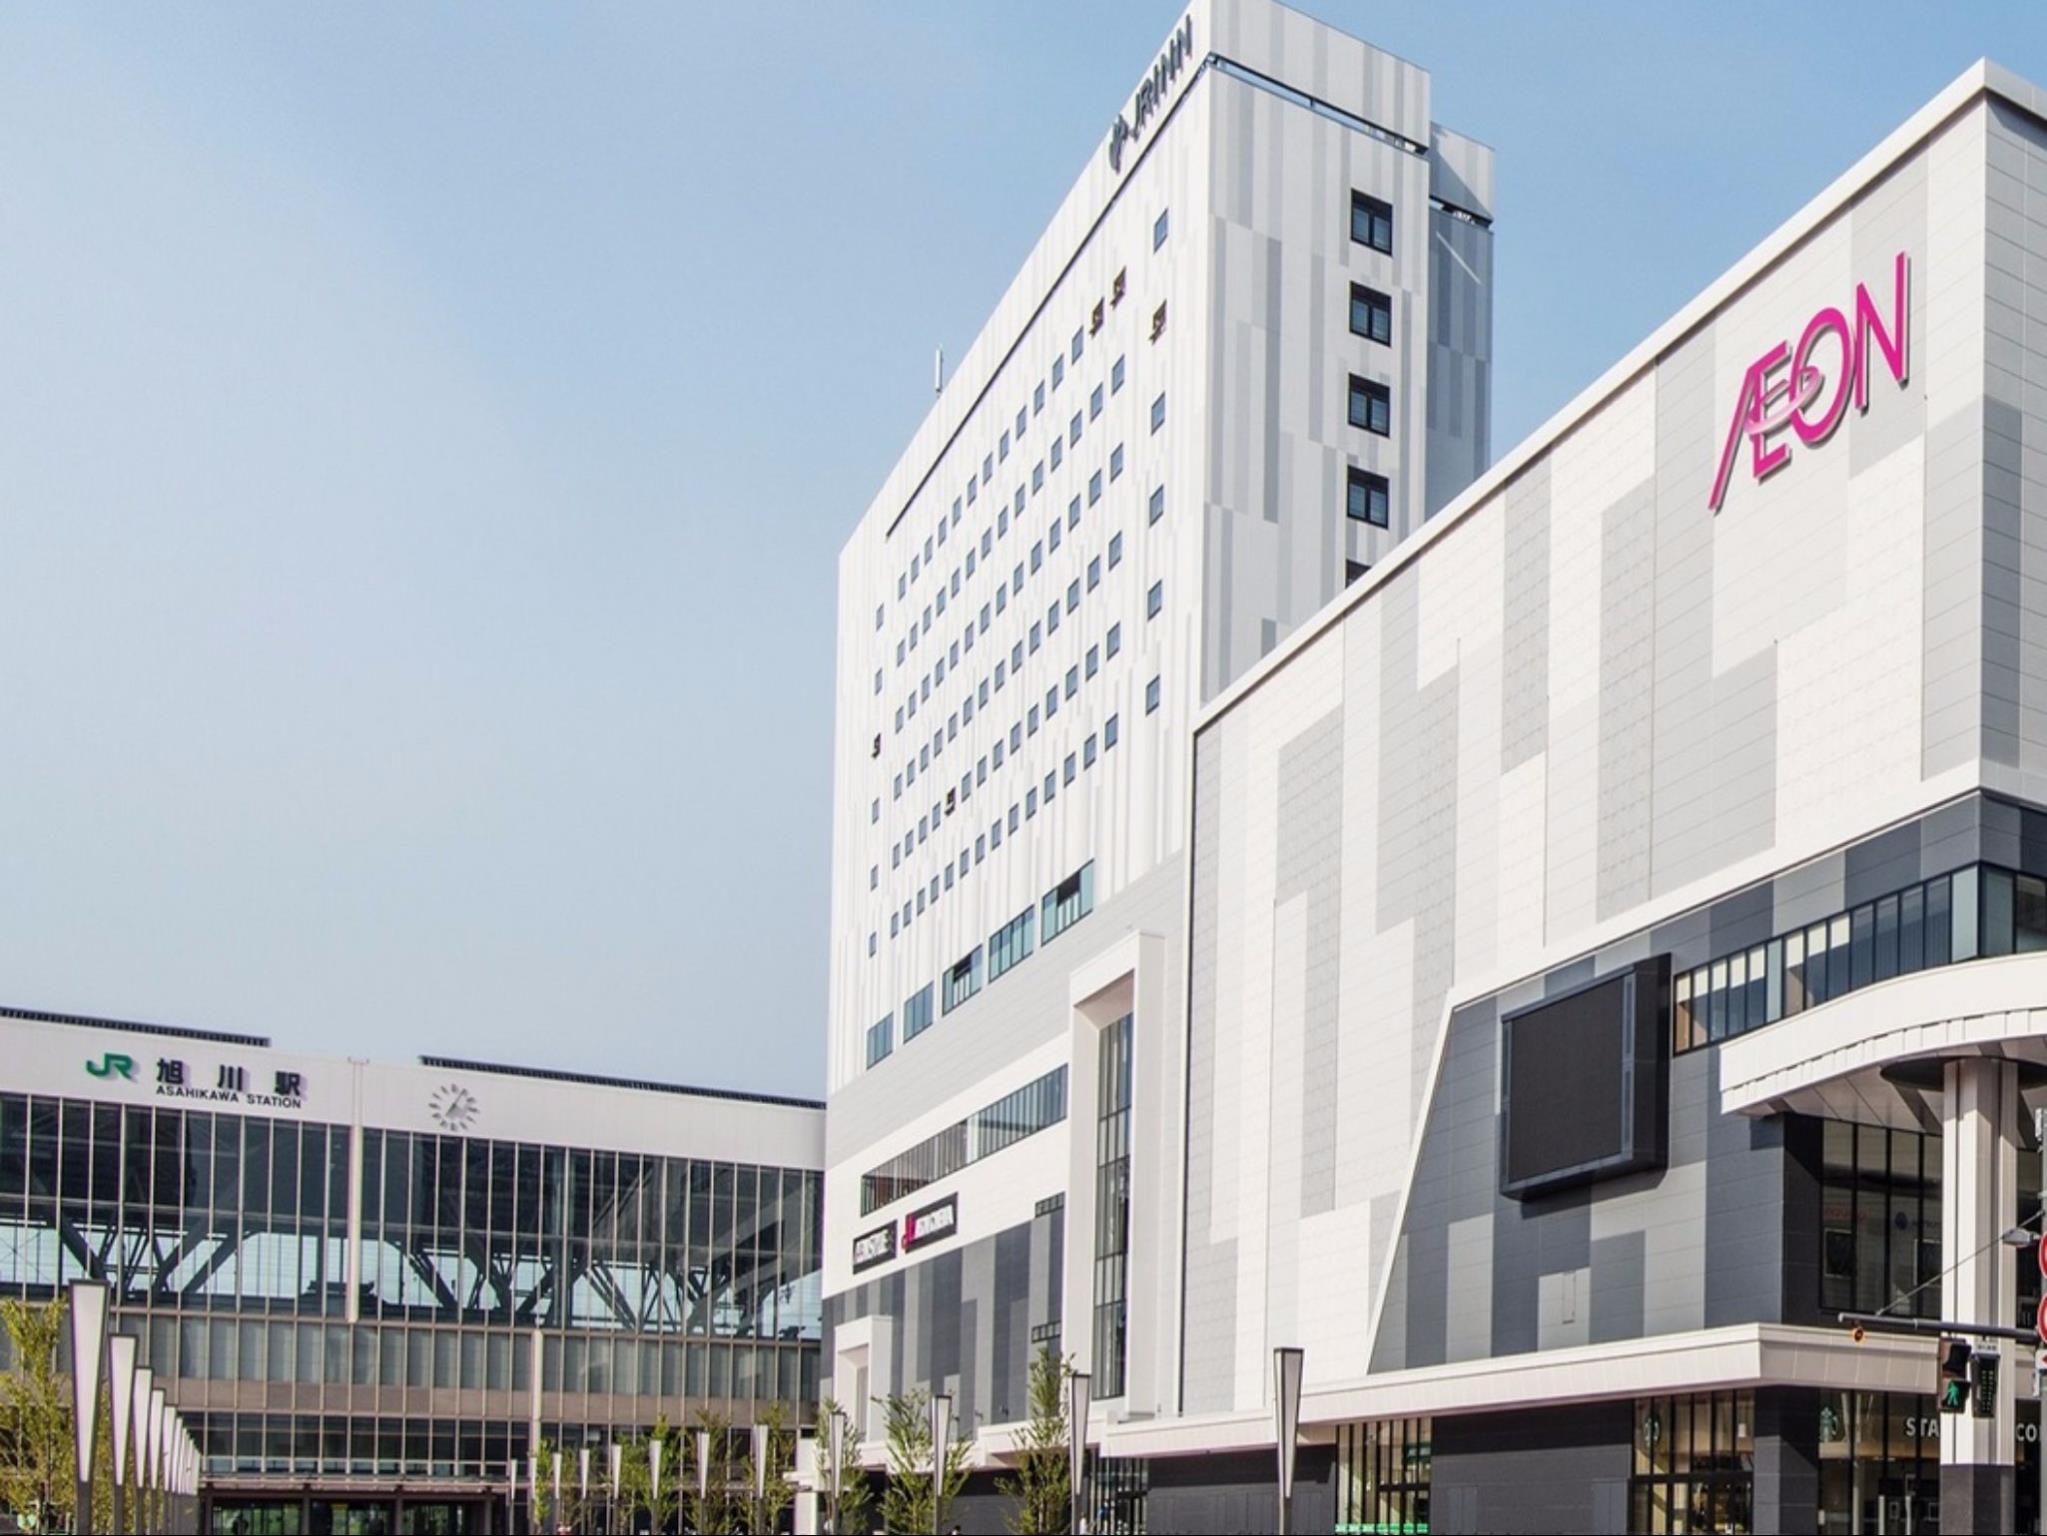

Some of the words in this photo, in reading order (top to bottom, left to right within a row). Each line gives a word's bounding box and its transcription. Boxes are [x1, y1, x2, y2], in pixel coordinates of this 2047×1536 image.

[86, 1053, 134, 1079] JR
[156, 1084, 239, 1103] ASAHIKAWA
[246, 1093, 302, 1109] STATION
[1906, 1416, 1940, 1438] STA
